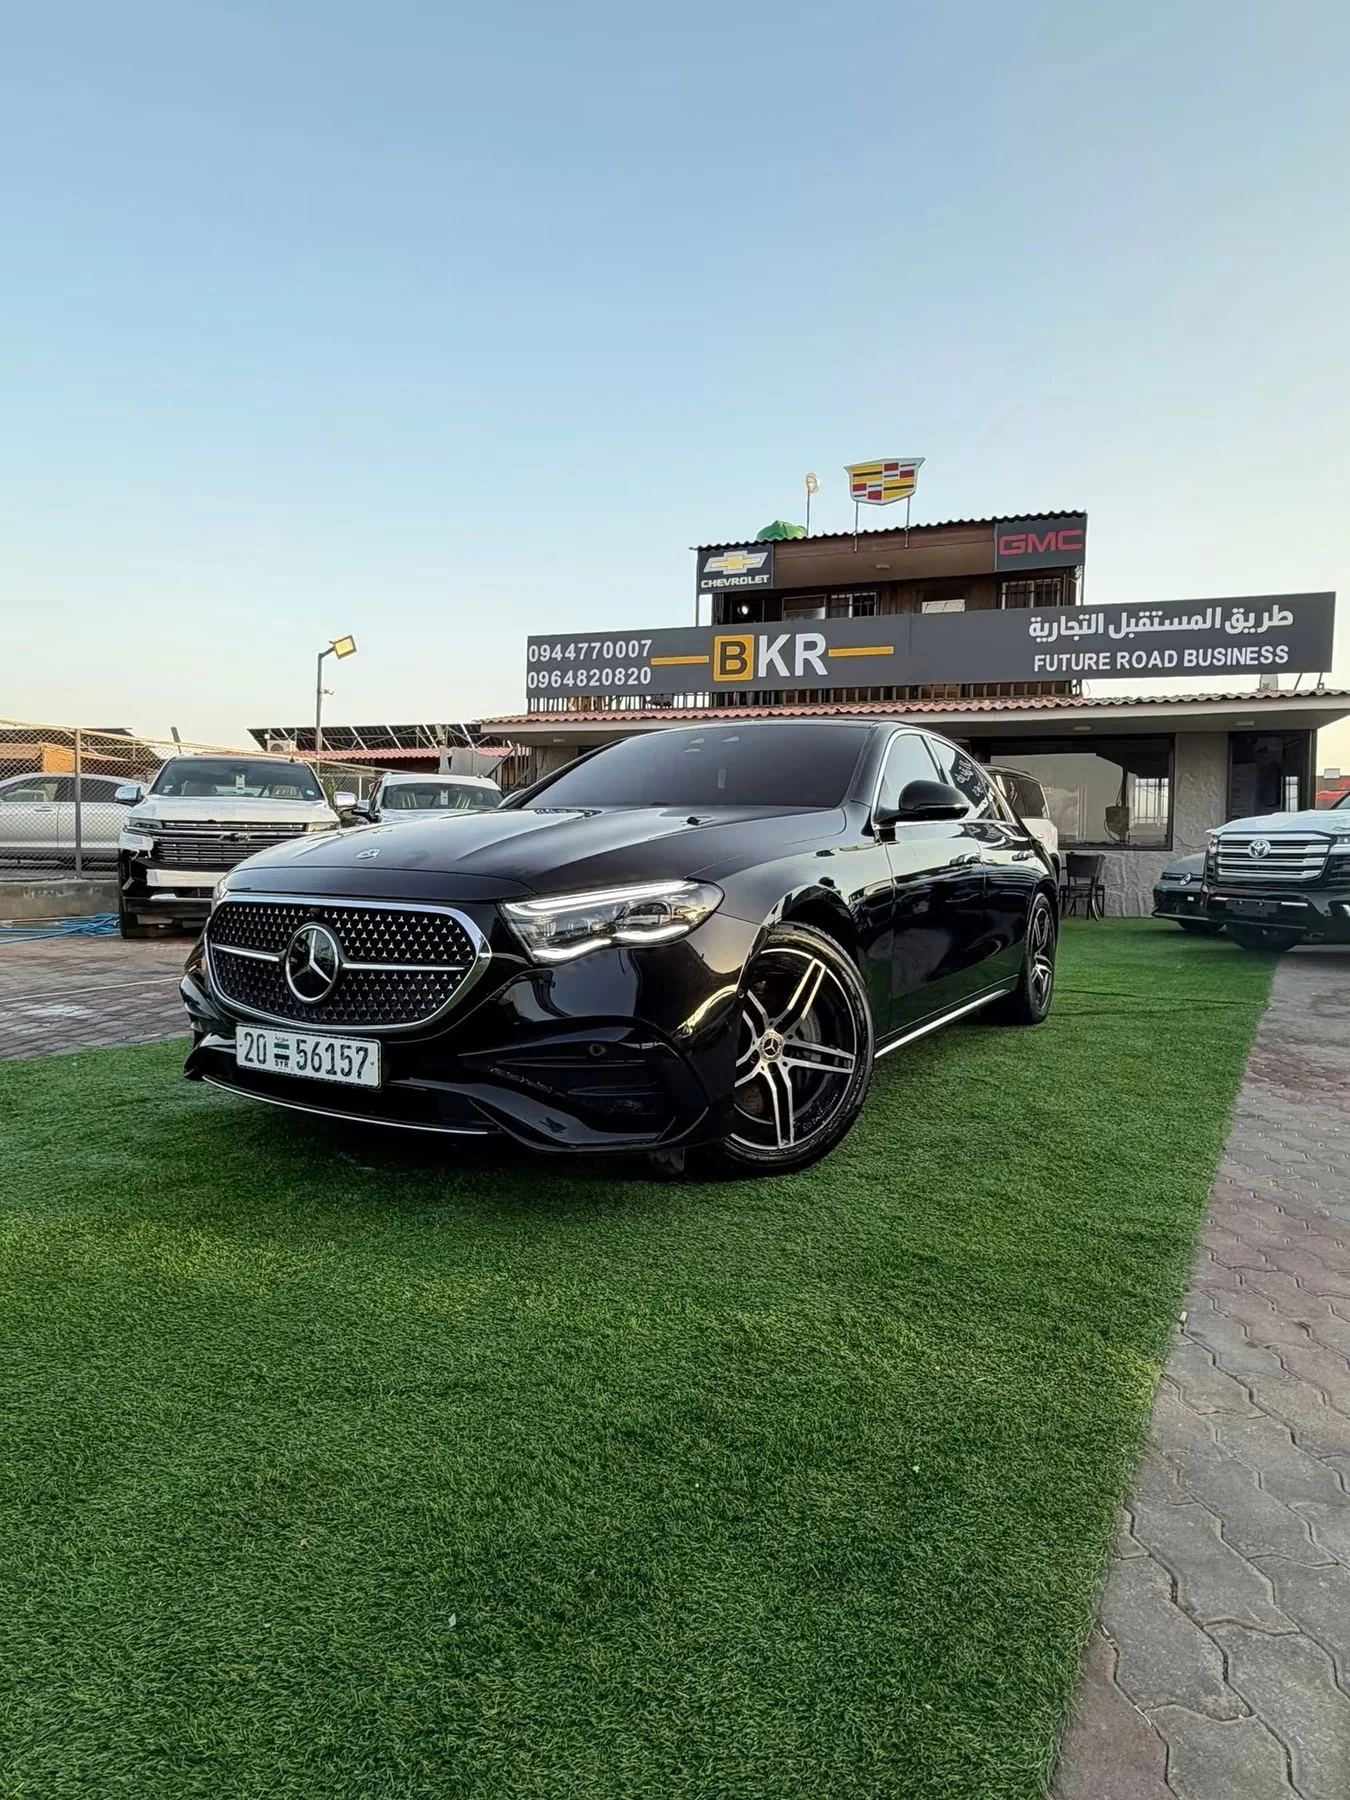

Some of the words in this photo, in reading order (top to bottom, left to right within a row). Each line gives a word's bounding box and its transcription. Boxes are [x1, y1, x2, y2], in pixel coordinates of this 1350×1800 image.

[999, 529, 1083, 555] GMC
[701, 575, 770, 588] CHEVROLET
[1028, 612, 1104, 643] التجارية
[1108, 606, 1222, 639] المستقبل
[1224, 604, 1294, 634] طريق
[528, 639, 652, 663] 0944770007
[718, 633, 829, 677] BKR
[1033, 652, 1111, 672] FUTURE
[1116, 649, 1178, 670] ROAD
[1183, 644, 1289, 668] BUSINESS
[527, 666, 652, 689] 0964820820
[244, 1032, 266, 1064] 20
[296, 1039, 369, 1079] 56157
[274, 1059, 289, 1068] SYR
